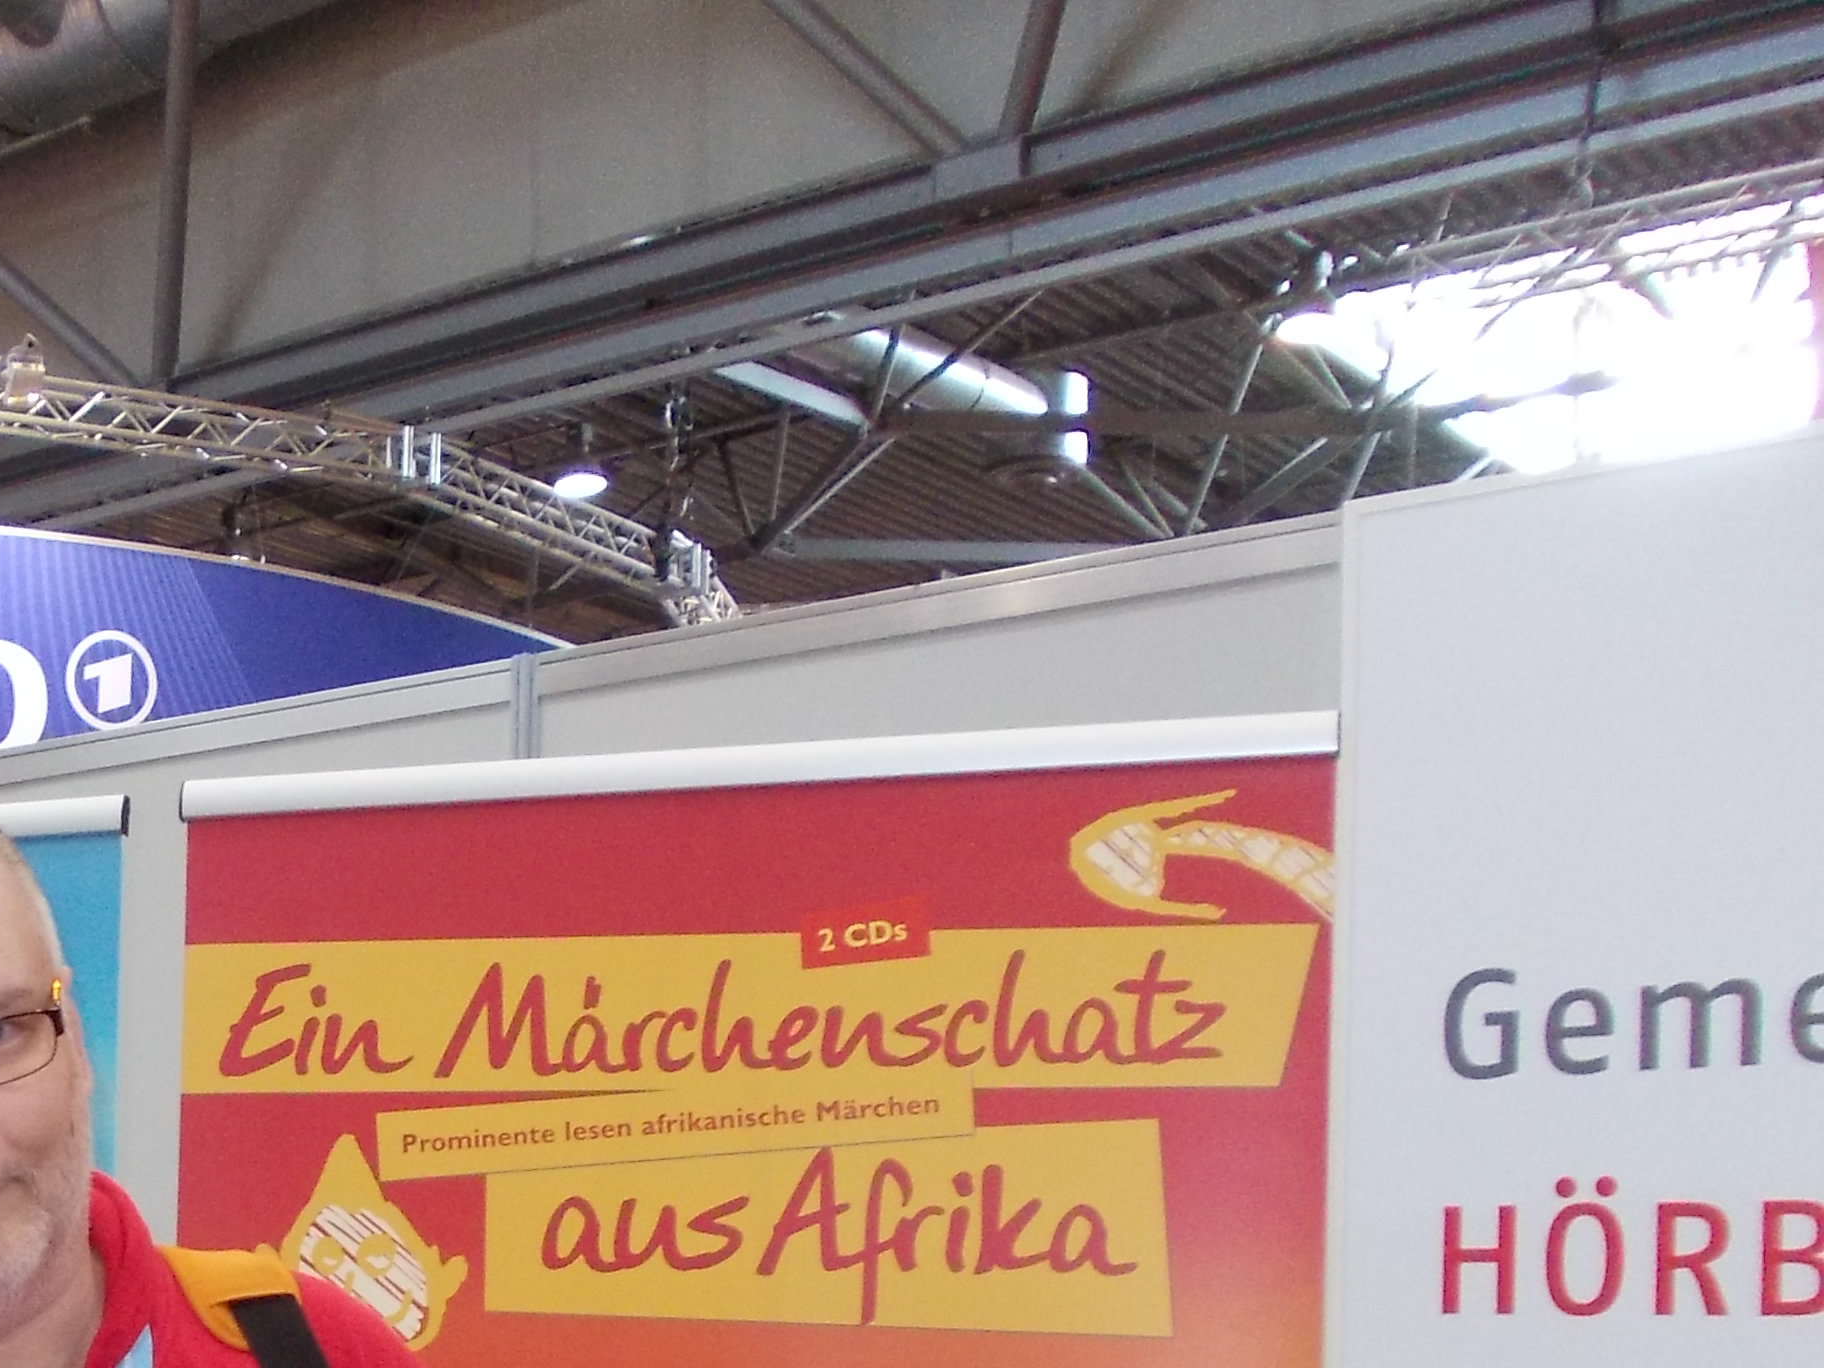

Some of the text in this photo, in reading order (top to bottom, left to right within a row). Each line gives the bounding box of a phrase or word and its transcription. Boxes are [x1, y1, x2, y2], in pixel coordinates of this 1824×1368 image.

[818, 920, 909, 952] 2 CDs
[218, 950, 1227, 1081] Ein Märchenschatz
[401, 1095, 940, 1154] Prominente lesen afrikanische Märchen
[541, 1147, 1138, 1325] aus Afrika
